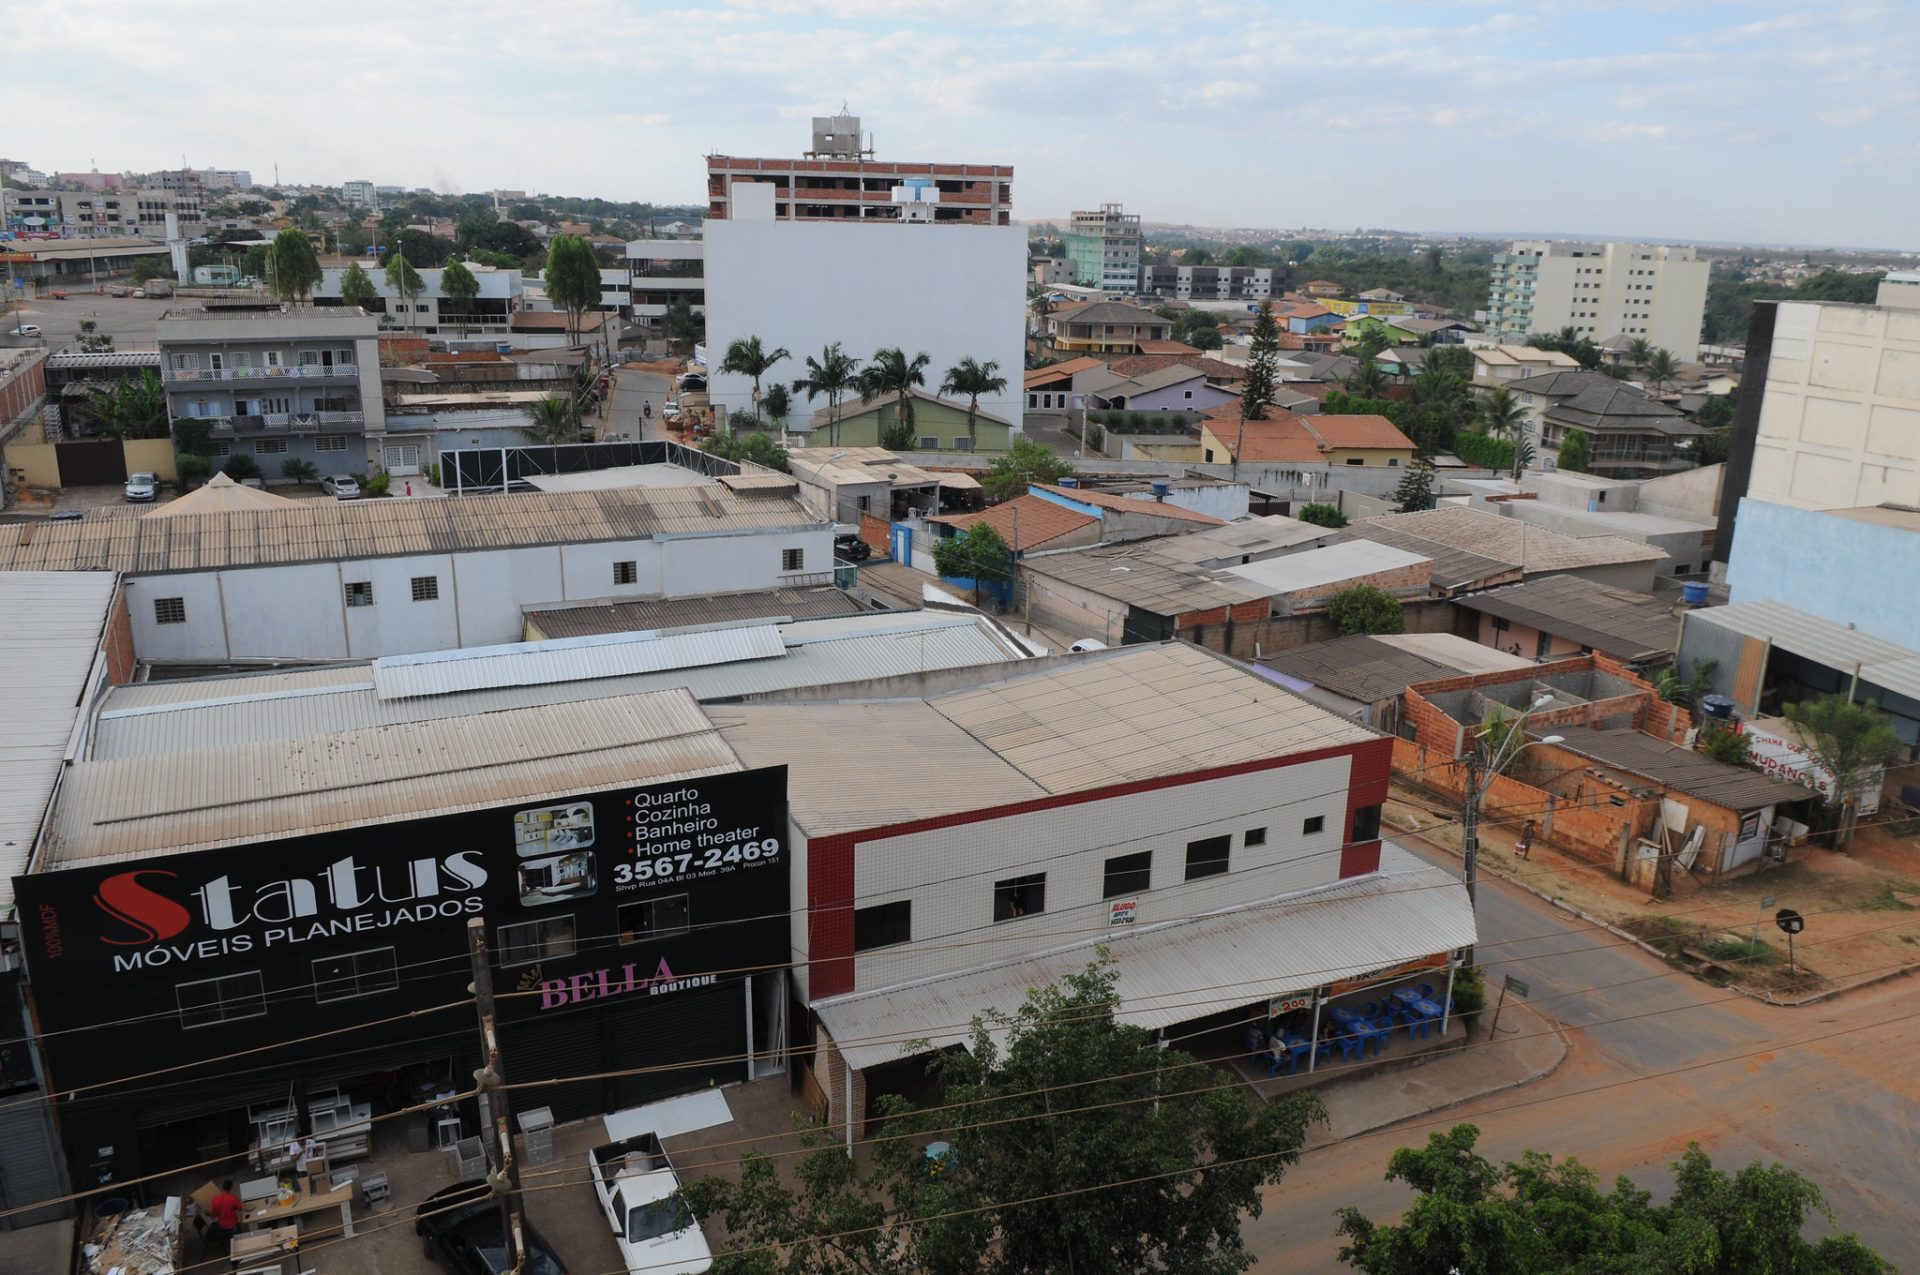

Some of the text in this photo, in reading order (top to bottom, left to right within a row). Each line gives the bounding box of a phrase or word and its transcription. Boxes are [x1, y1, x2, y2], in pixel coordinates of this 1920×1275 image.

[1755, 736, 1783, 746] CHAMA
[634, 787, 699, 808] Quarto
[635, 802, 711, 824] Cozinha
[635, 817, 718, 841] Banheiro
[636, 826, 760, 857] Home theater
[613, 838, 779, 884] 3567-2469
[615, 884, 637, 892] Shvp
[639, 880, 656, 888] Rua
[657, 877, 675, 885] 04A
[698, 869, 718, 878] Mod.
[720, 865, 736, 873] 39A
[742, 860, 766, 869] Procon
[768, 856, 779, 864] 151
[93, 850, 489, 945] Status
[1110, 902, 1136, 912] ALUGO
[113, 896, 484, 972] MÓVEIS PLANEJADOS
[539, 955, 678, 1010] BELLA
[650, 975, 717, 996] BOUTIQUE
